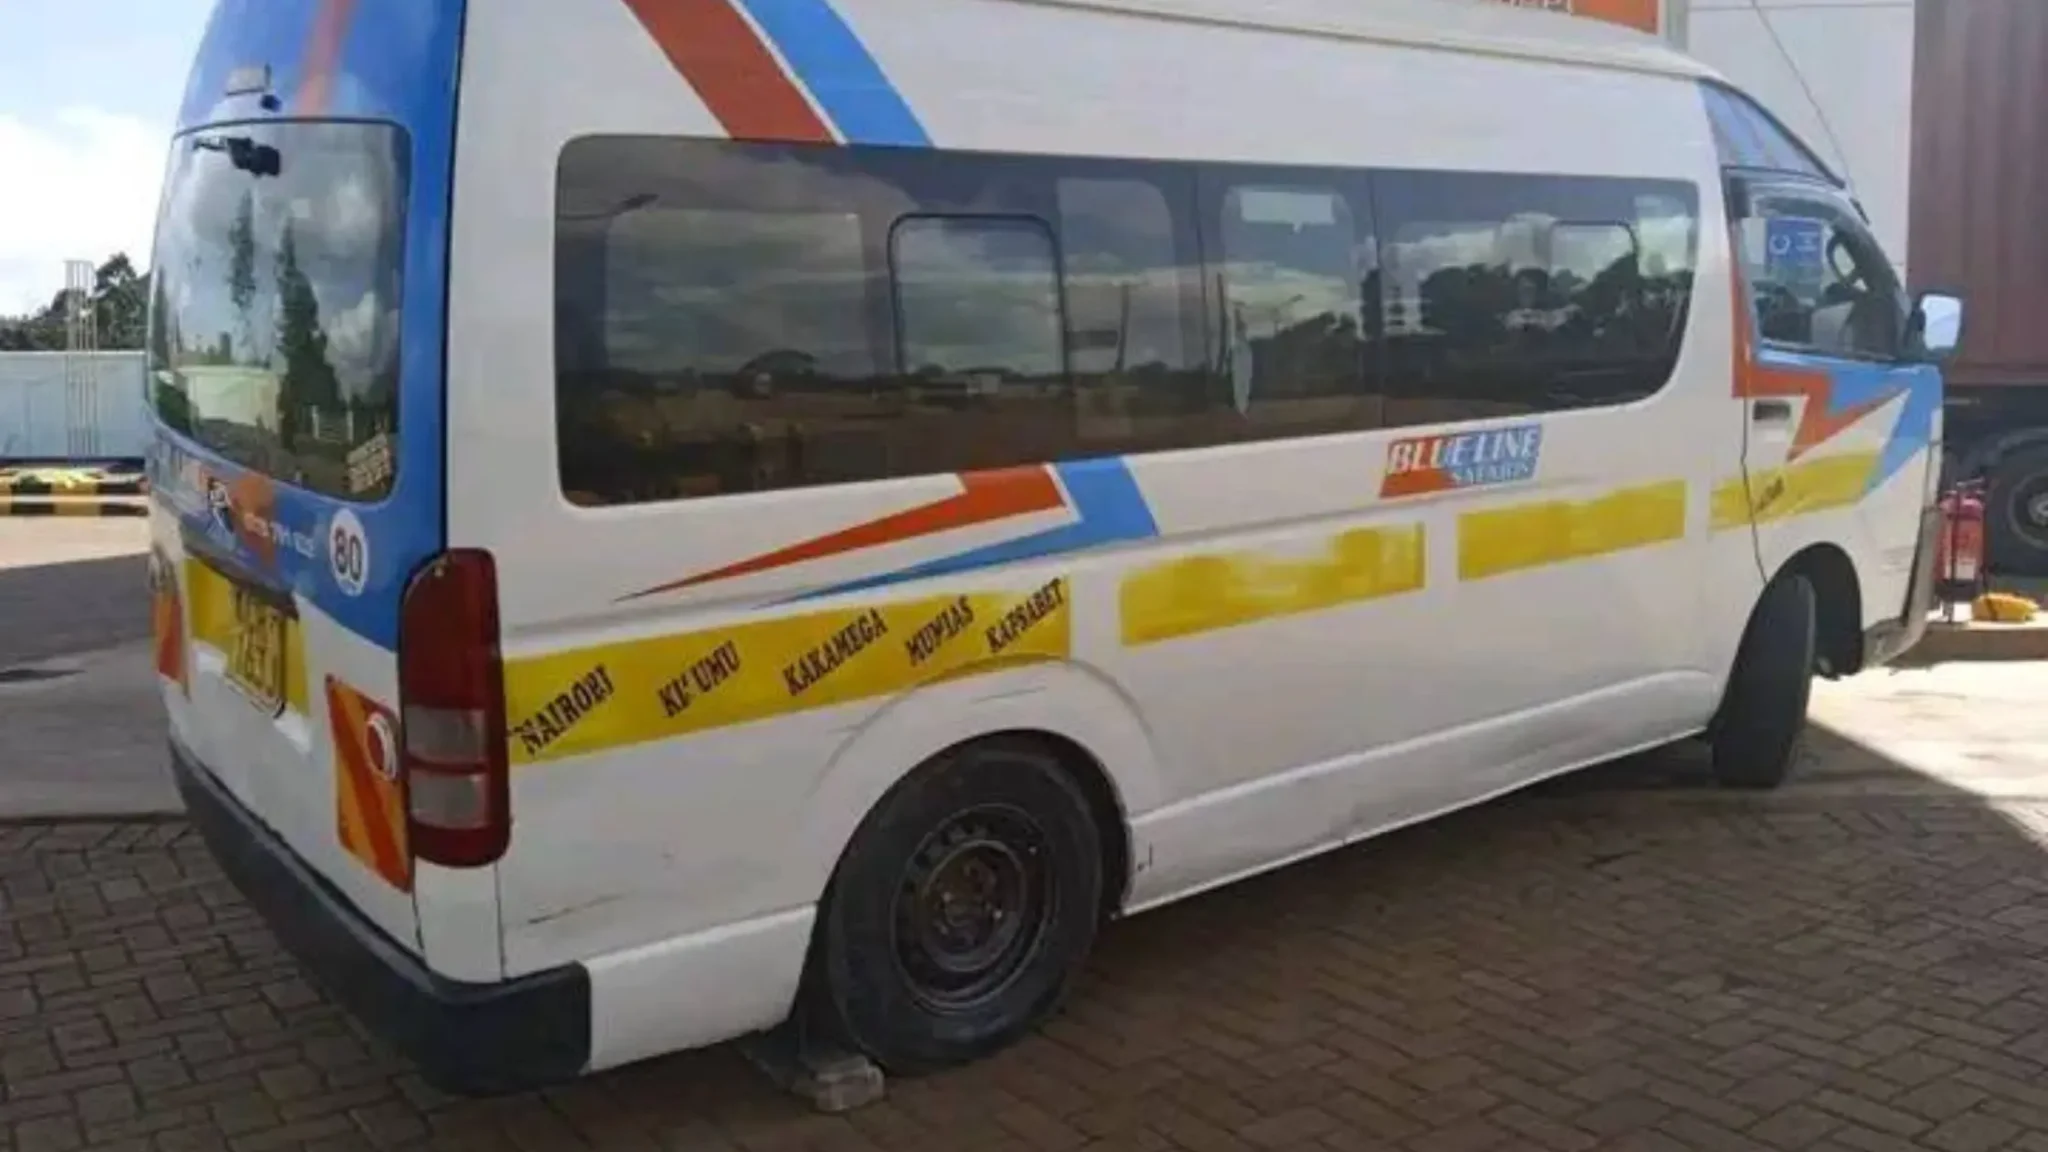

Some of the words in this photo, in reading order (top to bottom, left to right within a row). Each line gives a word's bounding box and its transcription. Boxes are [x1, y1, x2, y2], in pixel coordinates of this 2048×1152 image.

[335, 526, 364, 583] 80
[783, 608, 888, 696] KAKAMEGA
[985, 578, 1065, 653] KAPSABET
[515, 664, 614, 755] NAIROBI
